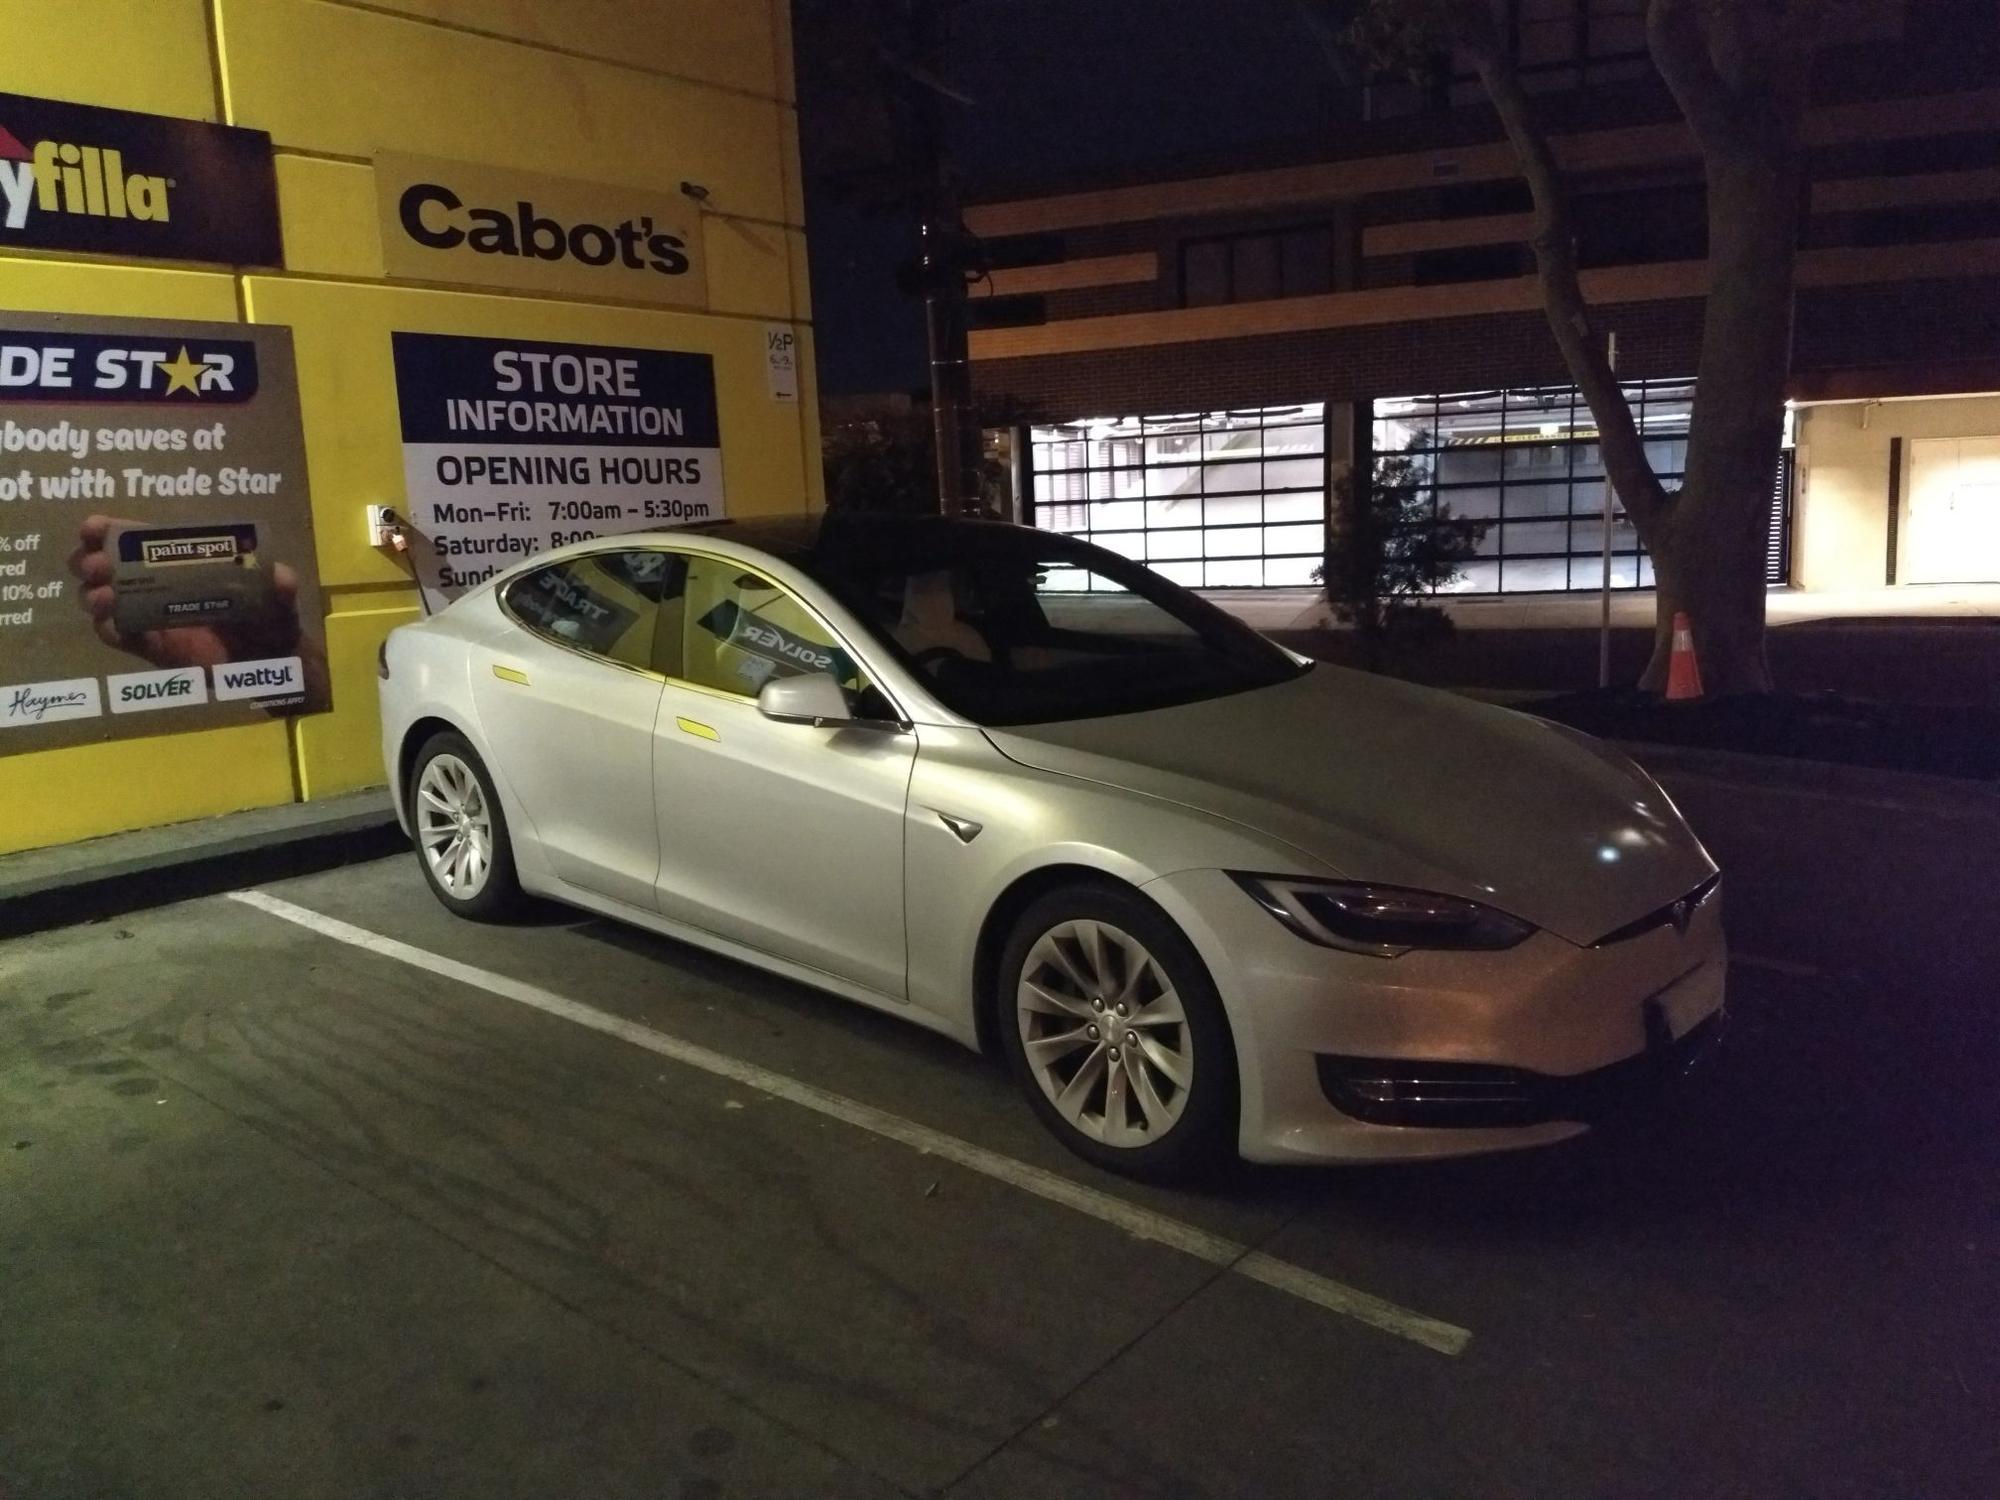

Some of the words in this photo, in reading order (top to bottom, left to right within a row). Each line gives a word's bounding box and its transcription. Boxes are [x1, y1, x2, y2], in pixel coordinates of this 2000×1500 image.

[400, 184, 690, 275] Cabot's
[1, 346, 75, 388] DE
[493, 350, 641, 397] STORE
[447, 399, 684, 436] INFORMATION
[0, 420, 89, 459] body
[96, 427, 187, 451] saves
[193, 422, 226, 451] at
[40, 466, 115, 499] with
[122, 467, 213, 498] Trade
[218, 466, 282, 495] Star
[436, 456, 590, 486] OPENING
[600, 457, 701, 485] HOURS
[548, 501, 621, 520] 7:00am
[644, 500, 709, 521] 5:30pm
[15, 534, 41, 551] off
[150, 541, 194, 560] paint
[197, 540, 232, 557] spot
[434, 533, 538, 557] Saturday:
[439, 565, 503, 587] Sund
[3, 584, 34, 601] 10%
[37, 581, 64, 599] off
[121, 674, 191, 701] SOLVER
[224, 666, 293, 689] wattyl
